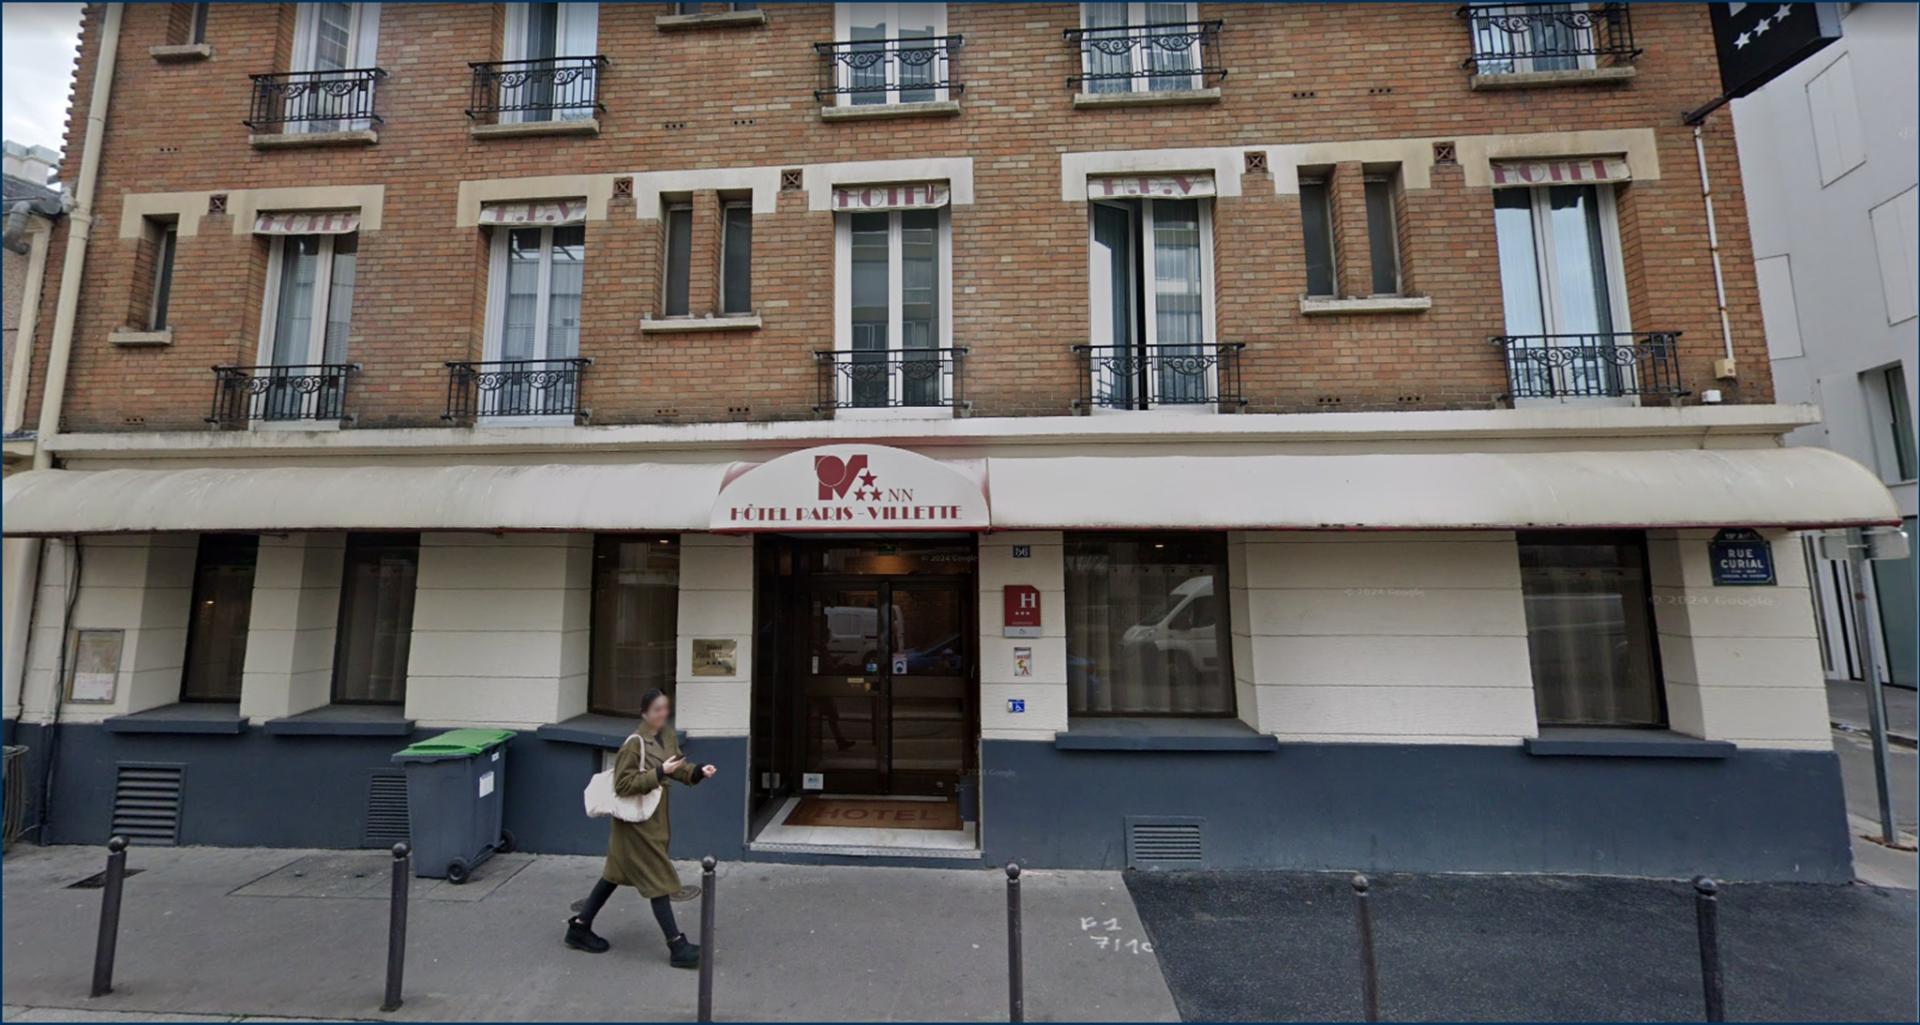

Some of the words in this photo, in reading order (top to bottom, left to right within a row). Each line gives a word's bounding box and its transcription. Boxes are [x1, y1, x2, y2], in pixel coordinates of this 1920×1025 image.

[888, 488, 914, 502] NN
[730, 503, 790, 521] HÔTEL
[1727, 549, 1754, 558] RUE
[1720, 559, 1764, 569] CURIAL
[1020, 593, 1036, 608] H
[814, 808, 940, 822] HOTEL
